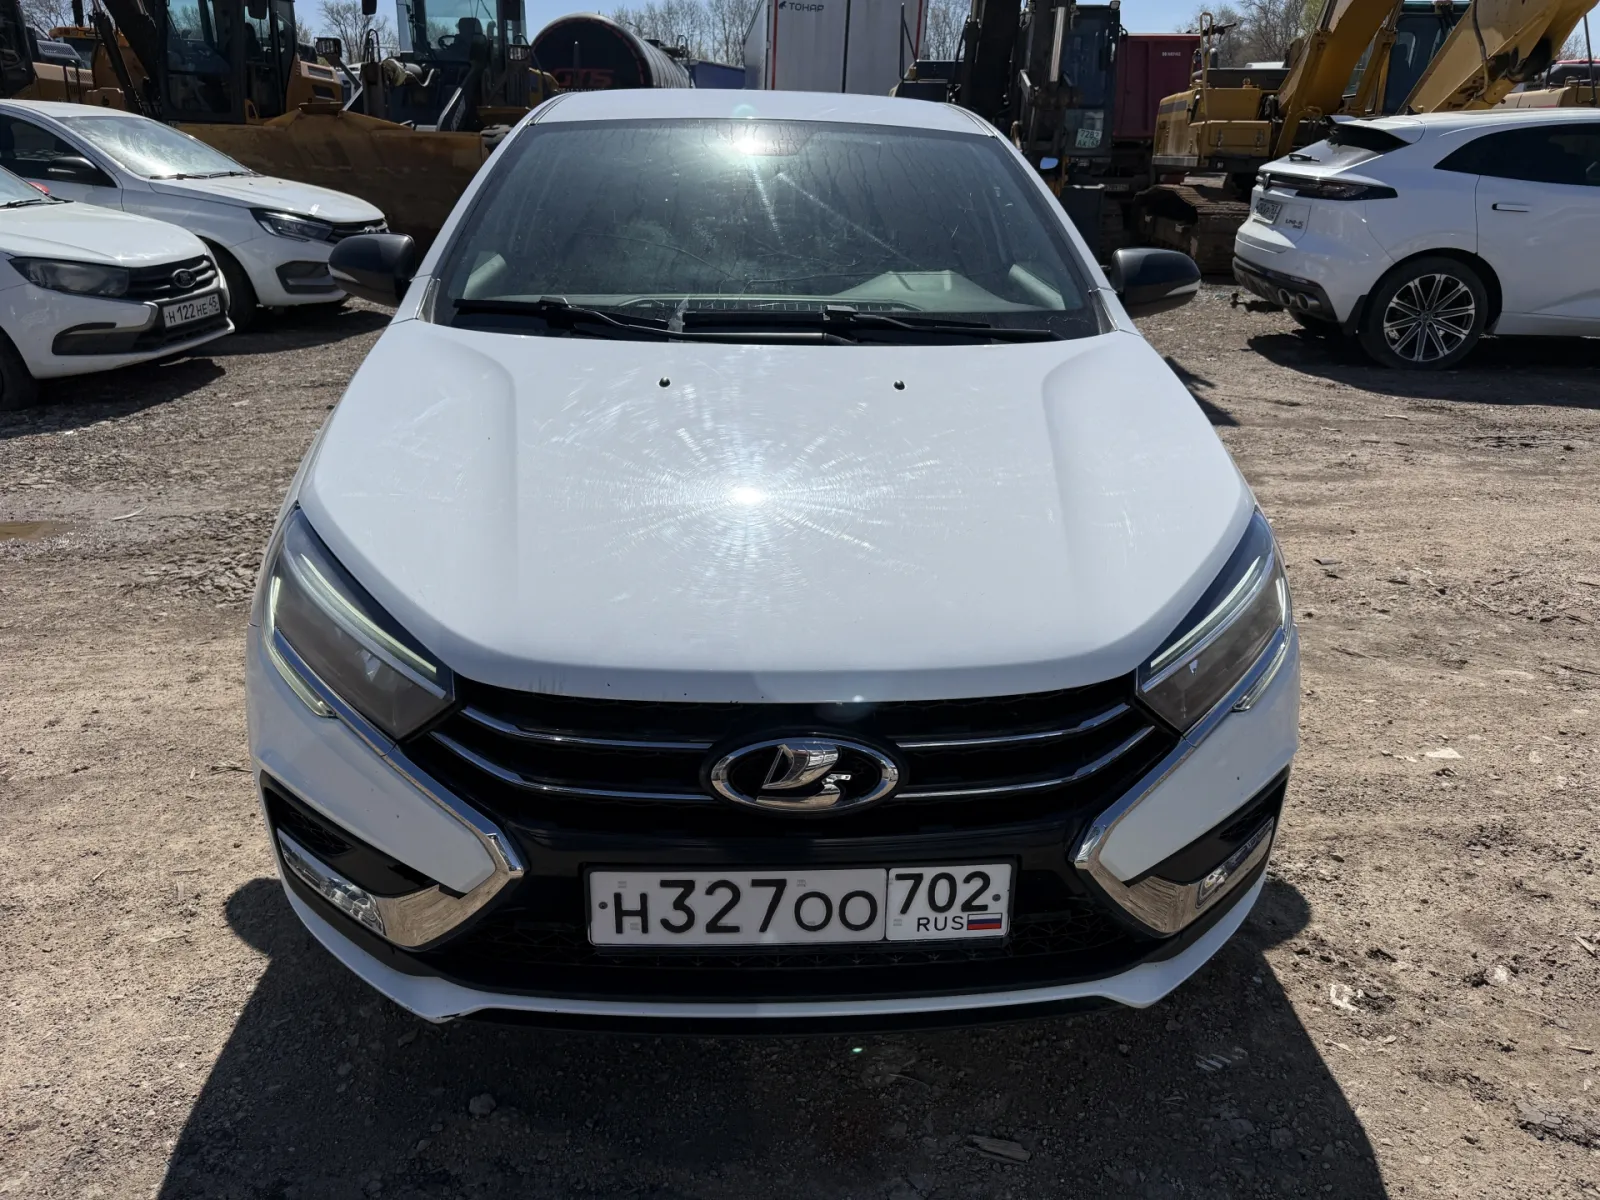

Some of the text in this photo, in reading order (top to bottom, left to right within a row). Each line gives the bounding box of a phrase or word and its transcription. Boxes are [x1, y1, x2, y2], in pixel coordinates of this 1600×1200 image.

[789, 2, 825, 12] ТОНАР
[895, 871, 991, 915] 702
[916, 915, 965, 932] RUS
